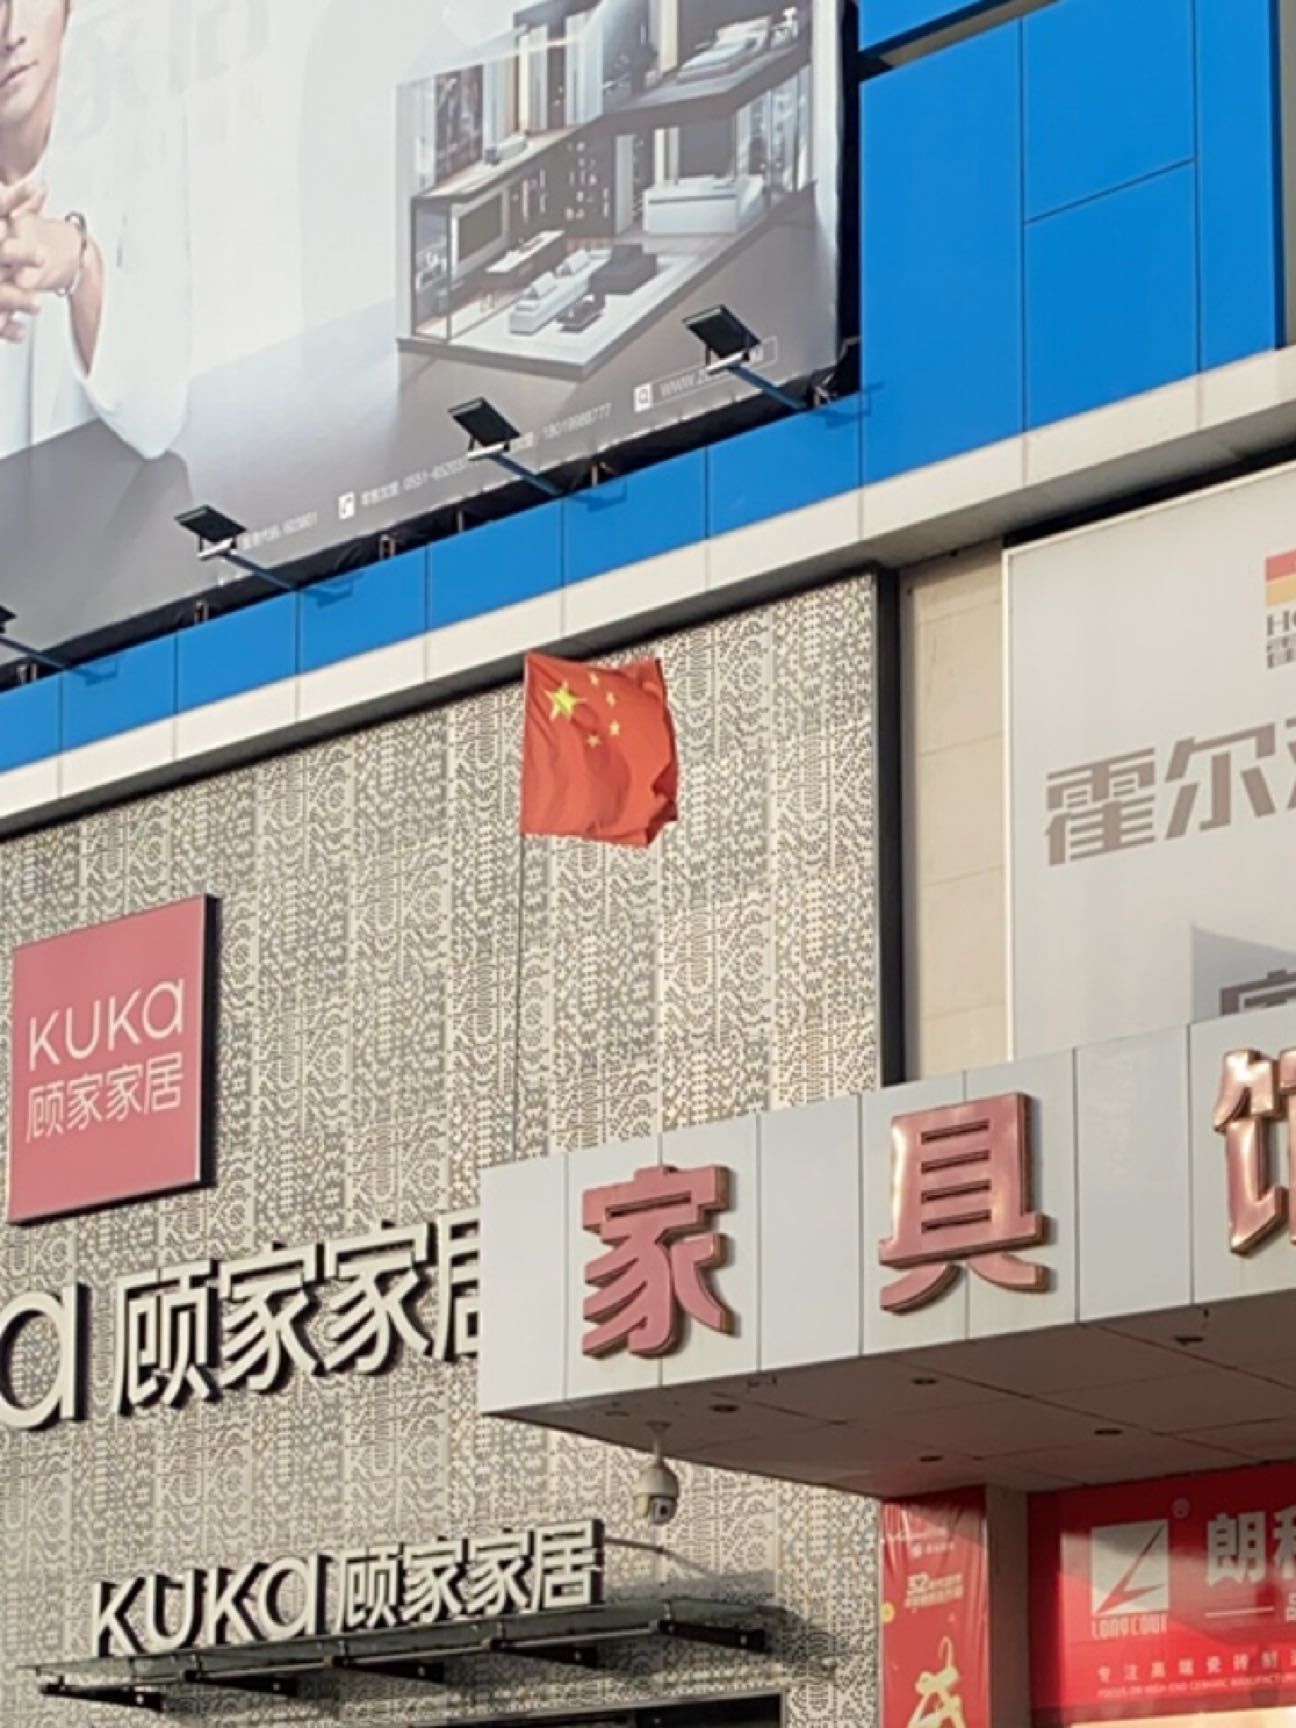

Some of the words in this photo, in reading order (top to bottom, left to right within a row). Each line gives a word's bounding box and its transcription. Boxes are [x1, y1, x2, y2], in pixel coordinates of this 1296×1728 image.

[25, 1052, 184, 1144] 顾家家居
[336, 1518, 600, 1633] 顾家家居
